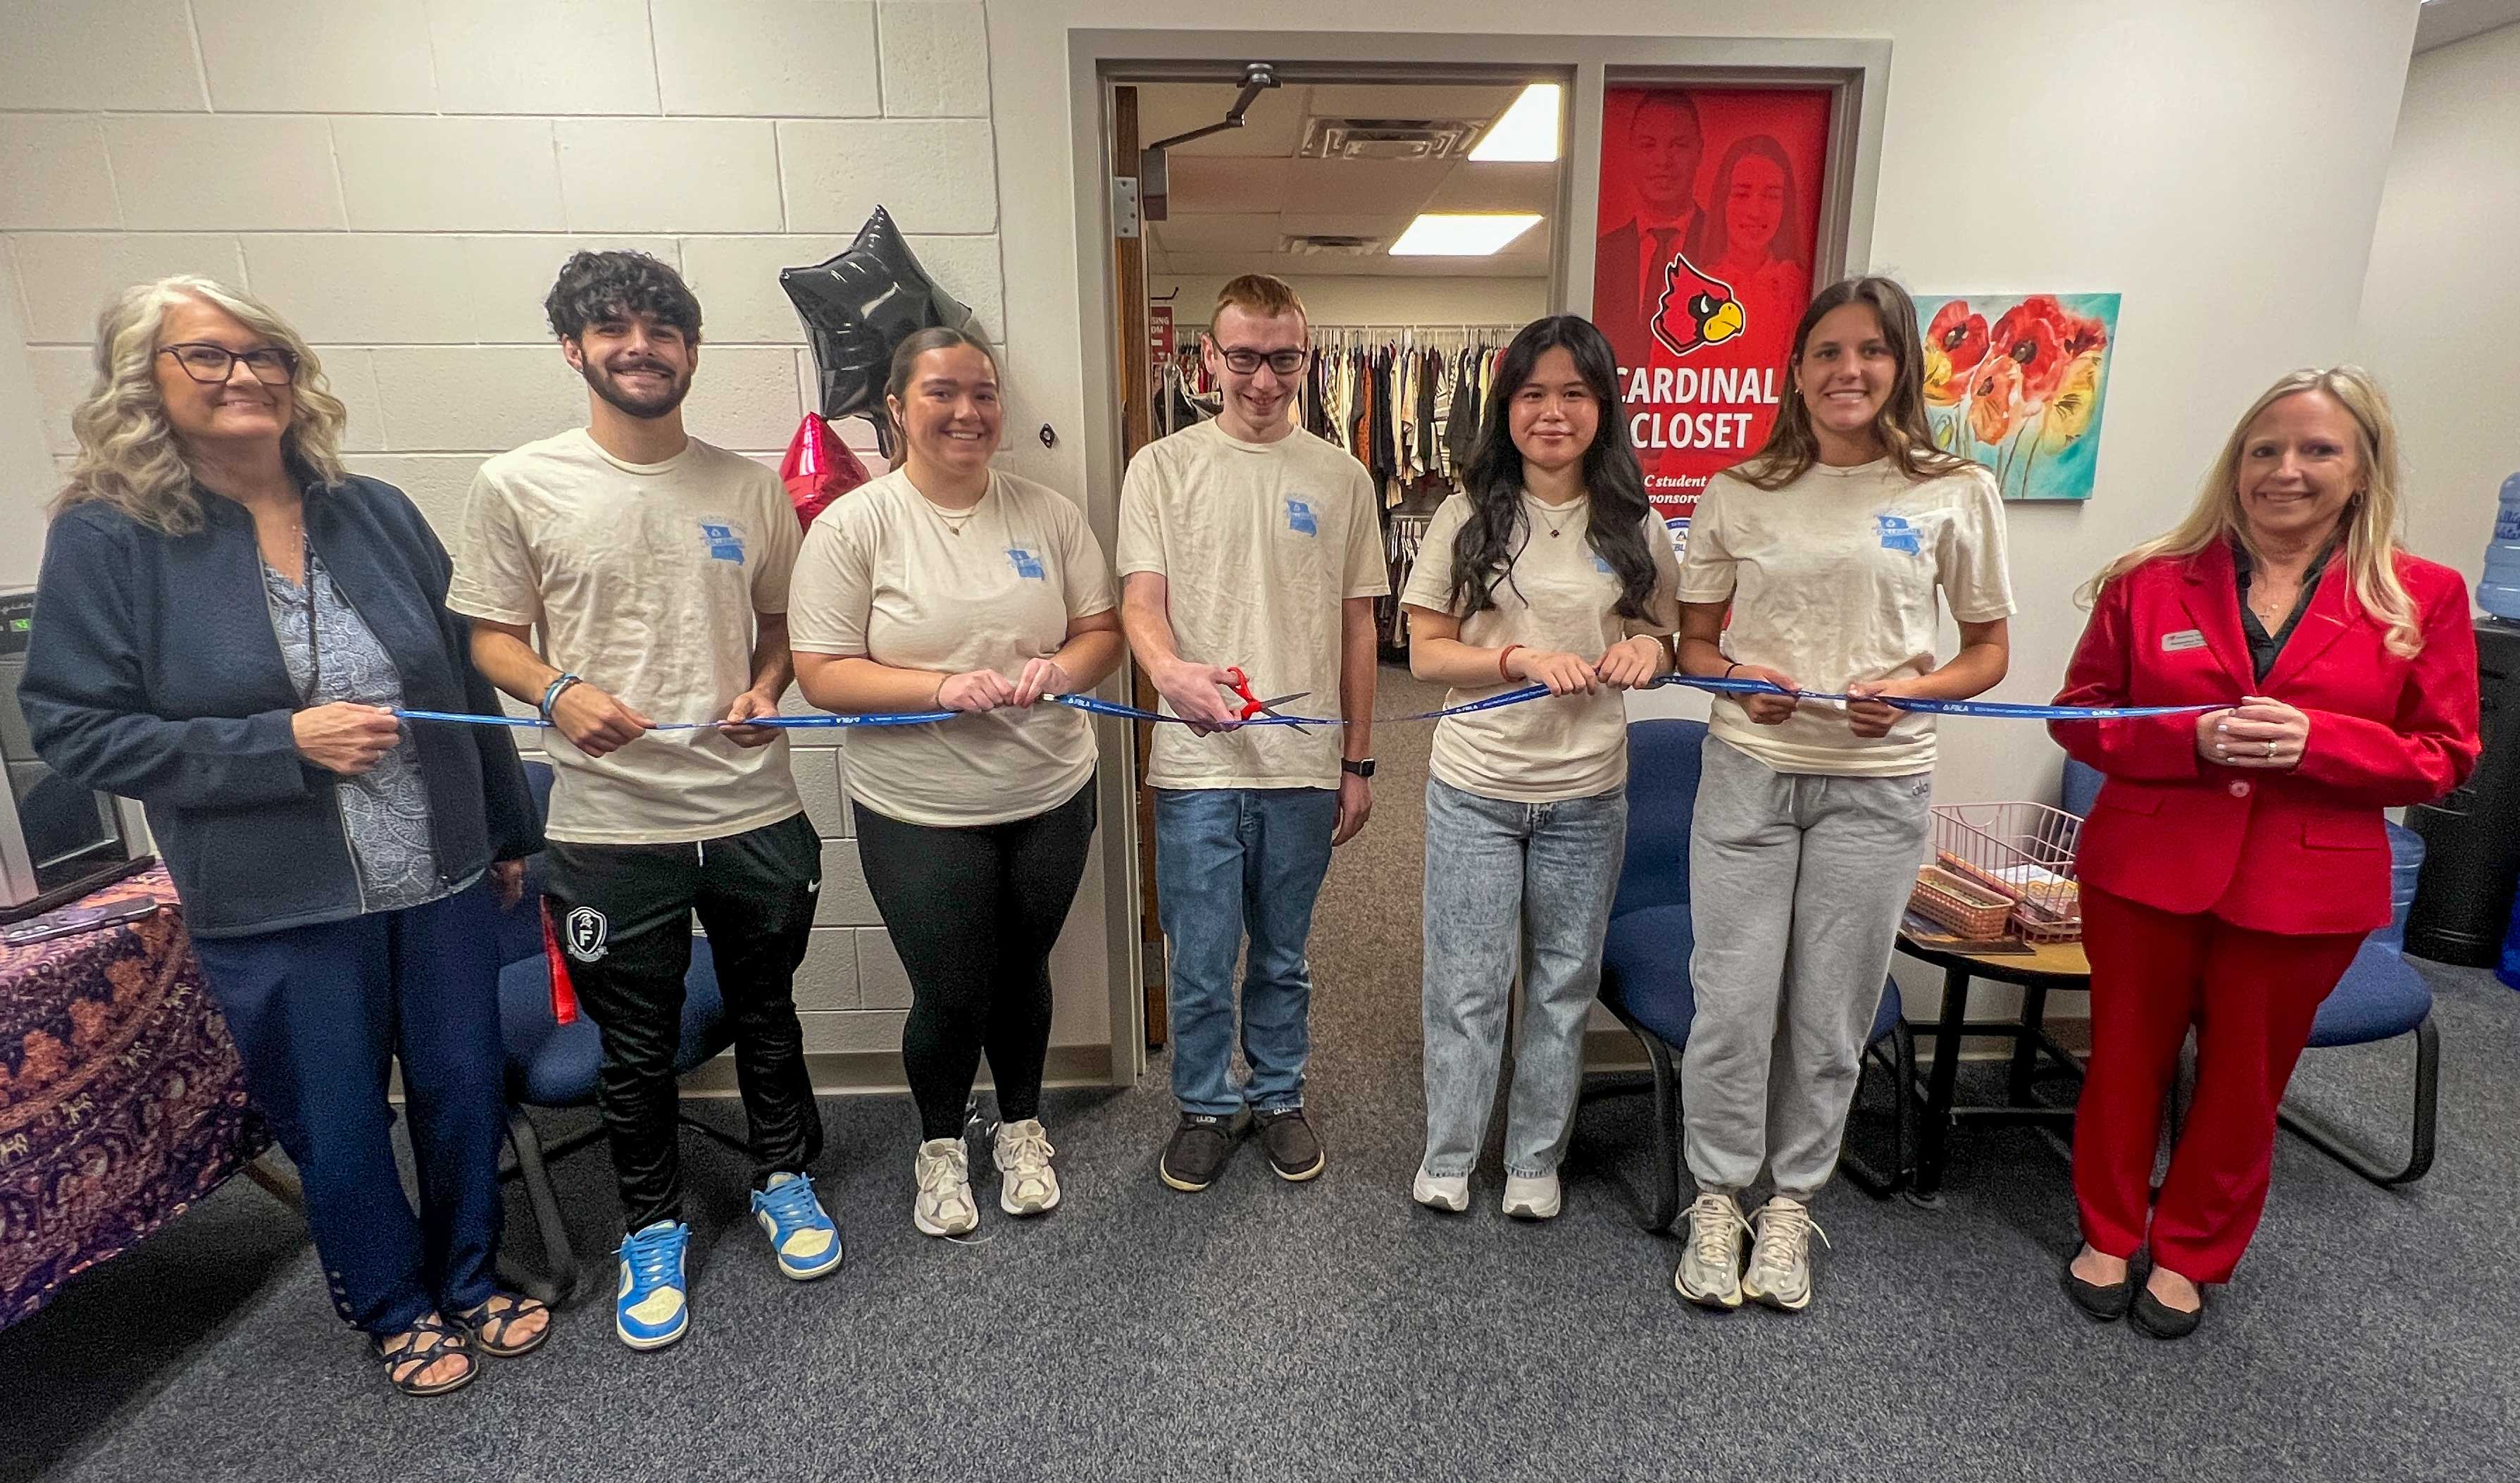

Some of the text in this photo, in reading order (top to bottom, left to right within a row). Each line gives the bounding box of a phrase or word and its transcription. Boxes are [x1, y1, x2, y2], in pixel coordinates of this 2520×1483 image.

[1630, 412, 1753, 449] CLOSET
[1655, 474, 1707, 488] student
[580, 930, 593, 945] F
